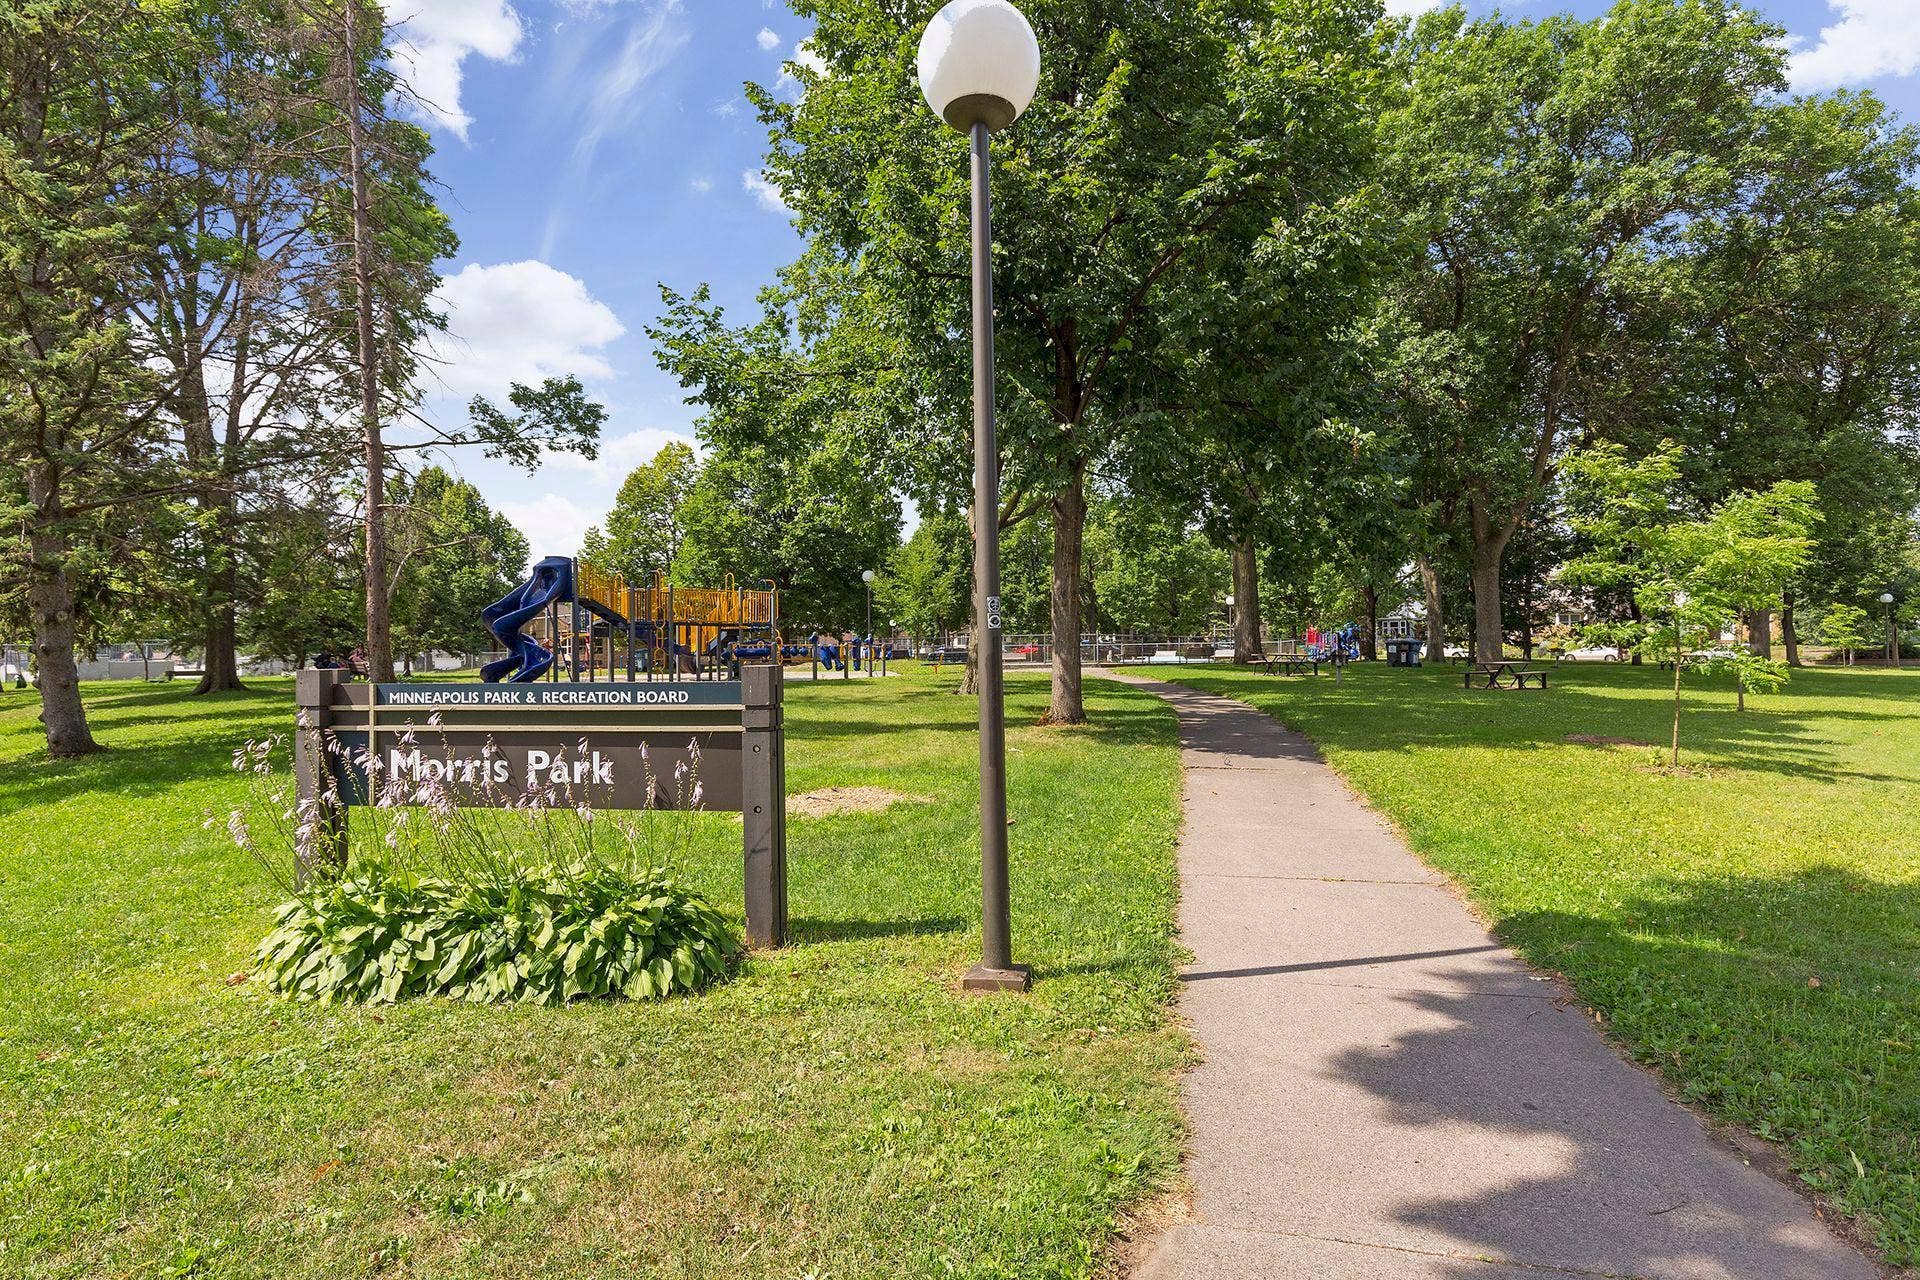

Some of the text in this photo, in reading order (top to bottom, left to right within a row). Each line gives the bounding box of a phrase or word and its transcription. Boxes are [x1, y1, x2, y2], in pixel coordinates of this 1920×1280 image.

[389, 690, 689, 704] MINNEAPOLIS PARK & RECREATION BOARD
[390, 749, 615, 785] Morris Park
